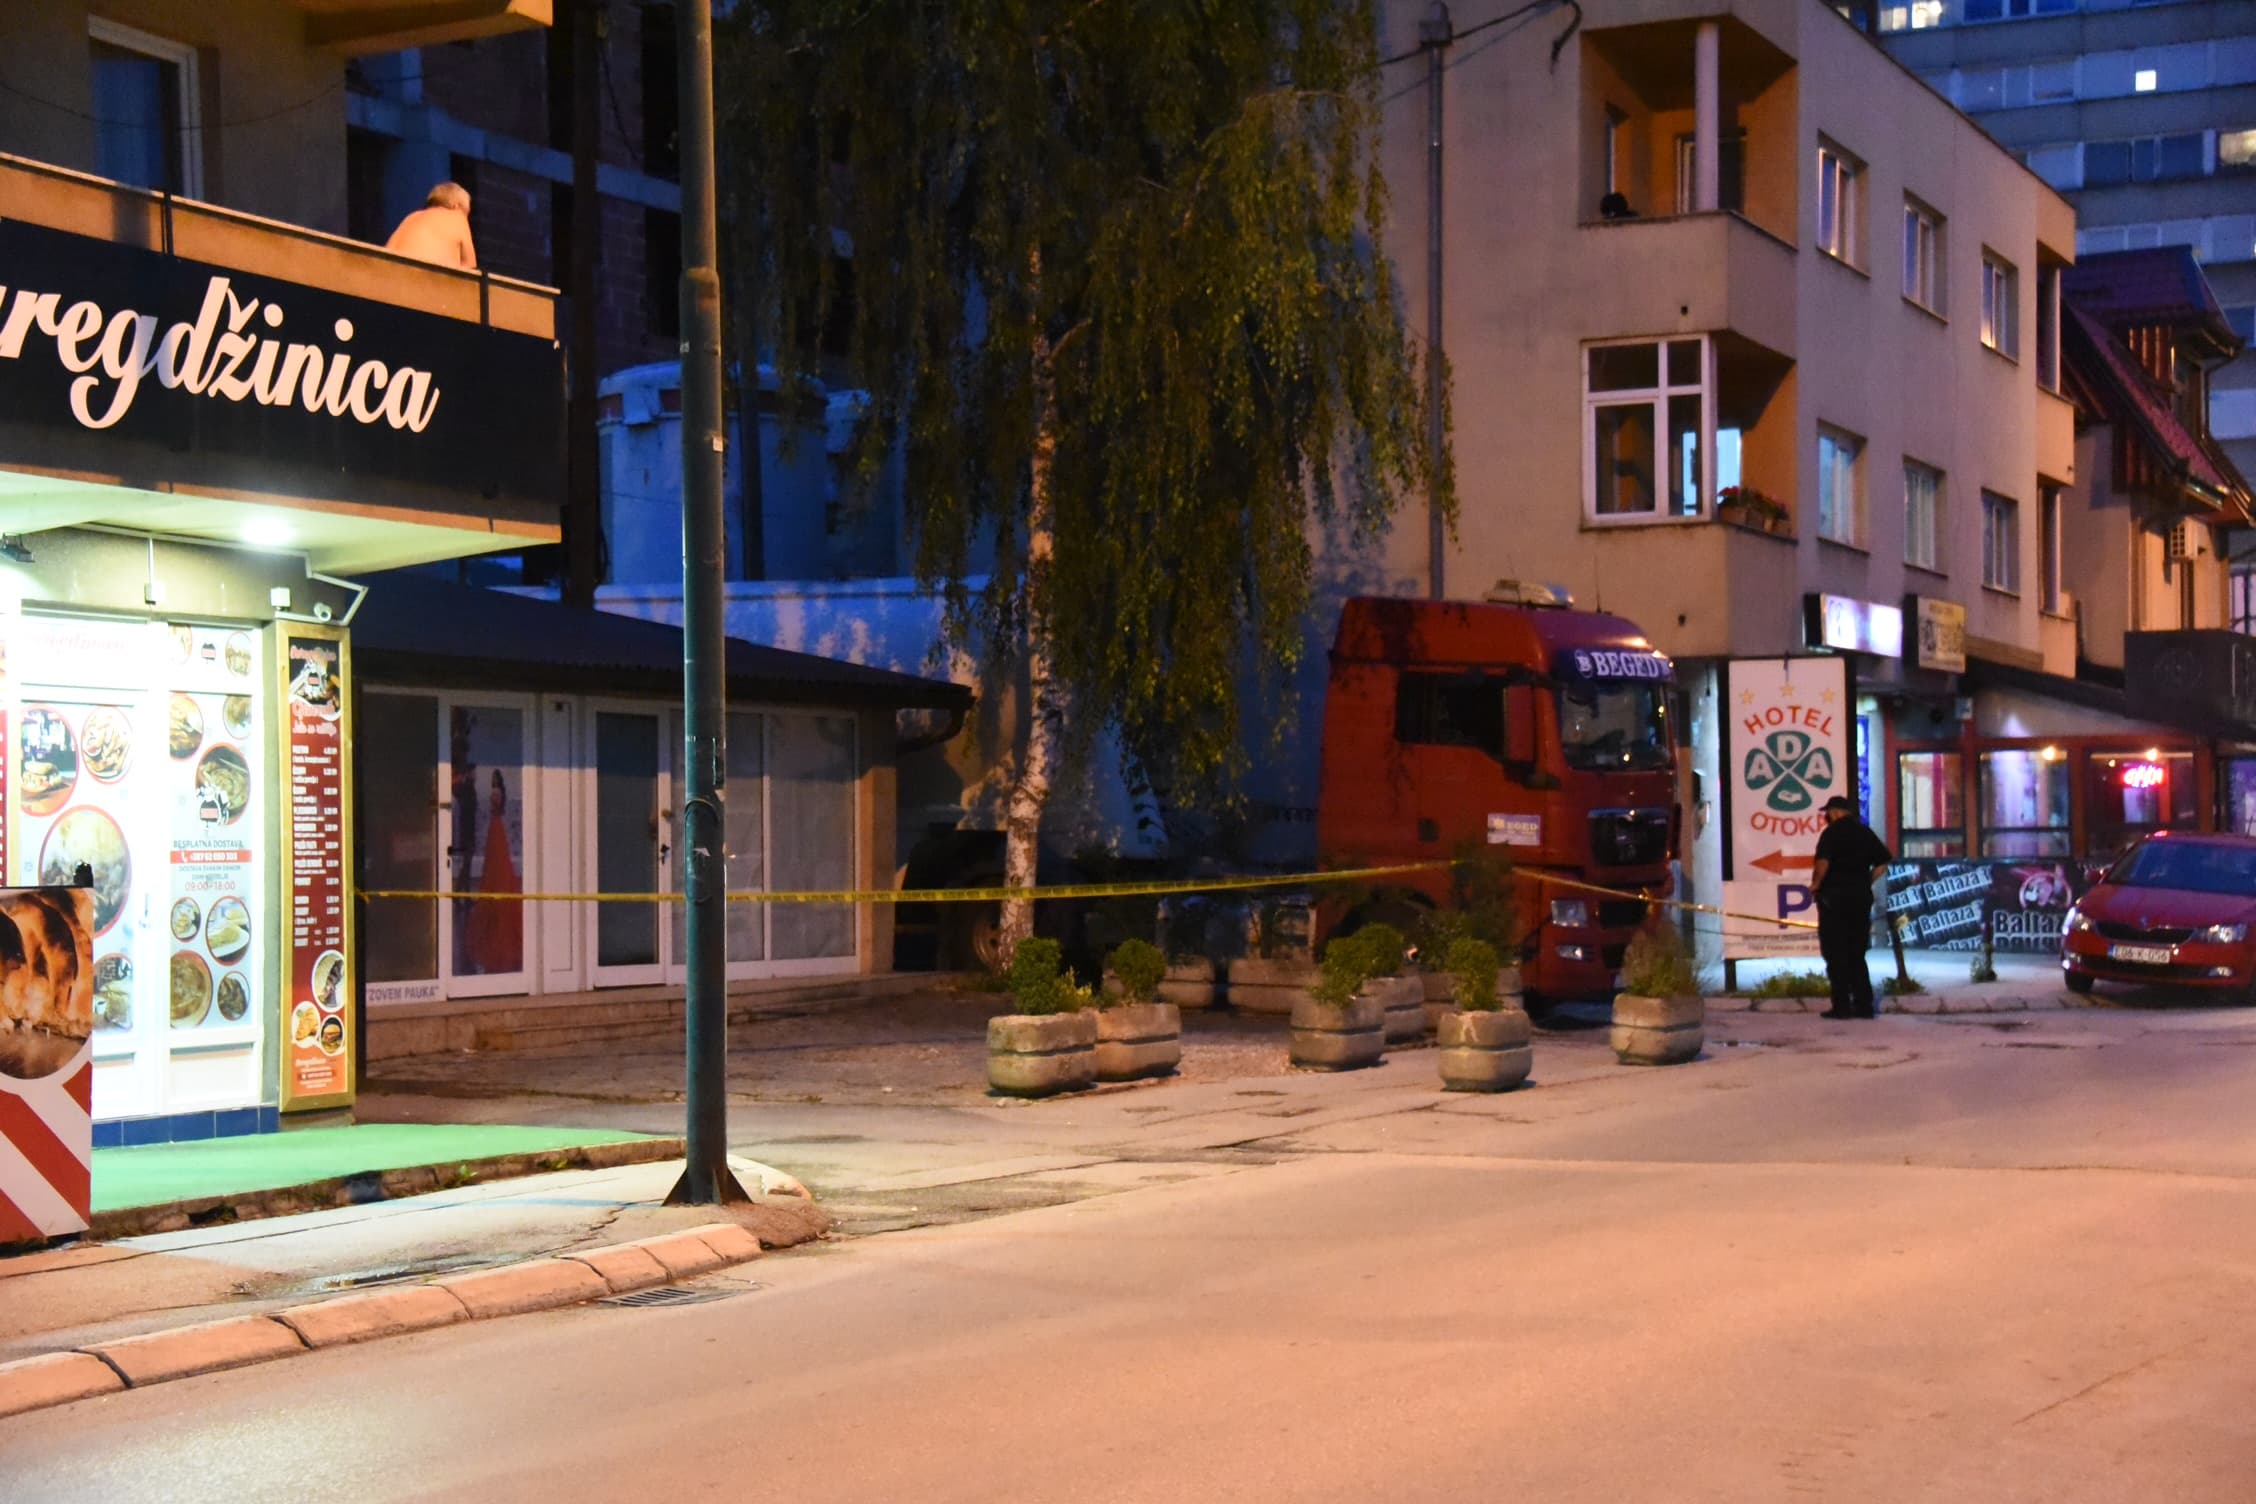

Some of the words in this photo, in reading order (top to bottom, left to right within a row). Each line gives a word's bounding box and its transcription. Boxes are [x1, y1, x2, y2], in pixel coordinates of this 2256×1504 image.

[0, 276, 440, 433] regdžinica
[1591, 652, 1659, 677] BEGED
[1744, 705, 1832, 737] HOTEL
[1747, 734, 1832, 780] ADA
[173, 840, 212, 849] BESPLATNA
[213, 840, 244, 848] DOSTAVA
[1777, 884, 1813, 930] P
[1993, 909, 2063, 936] Baltaz
